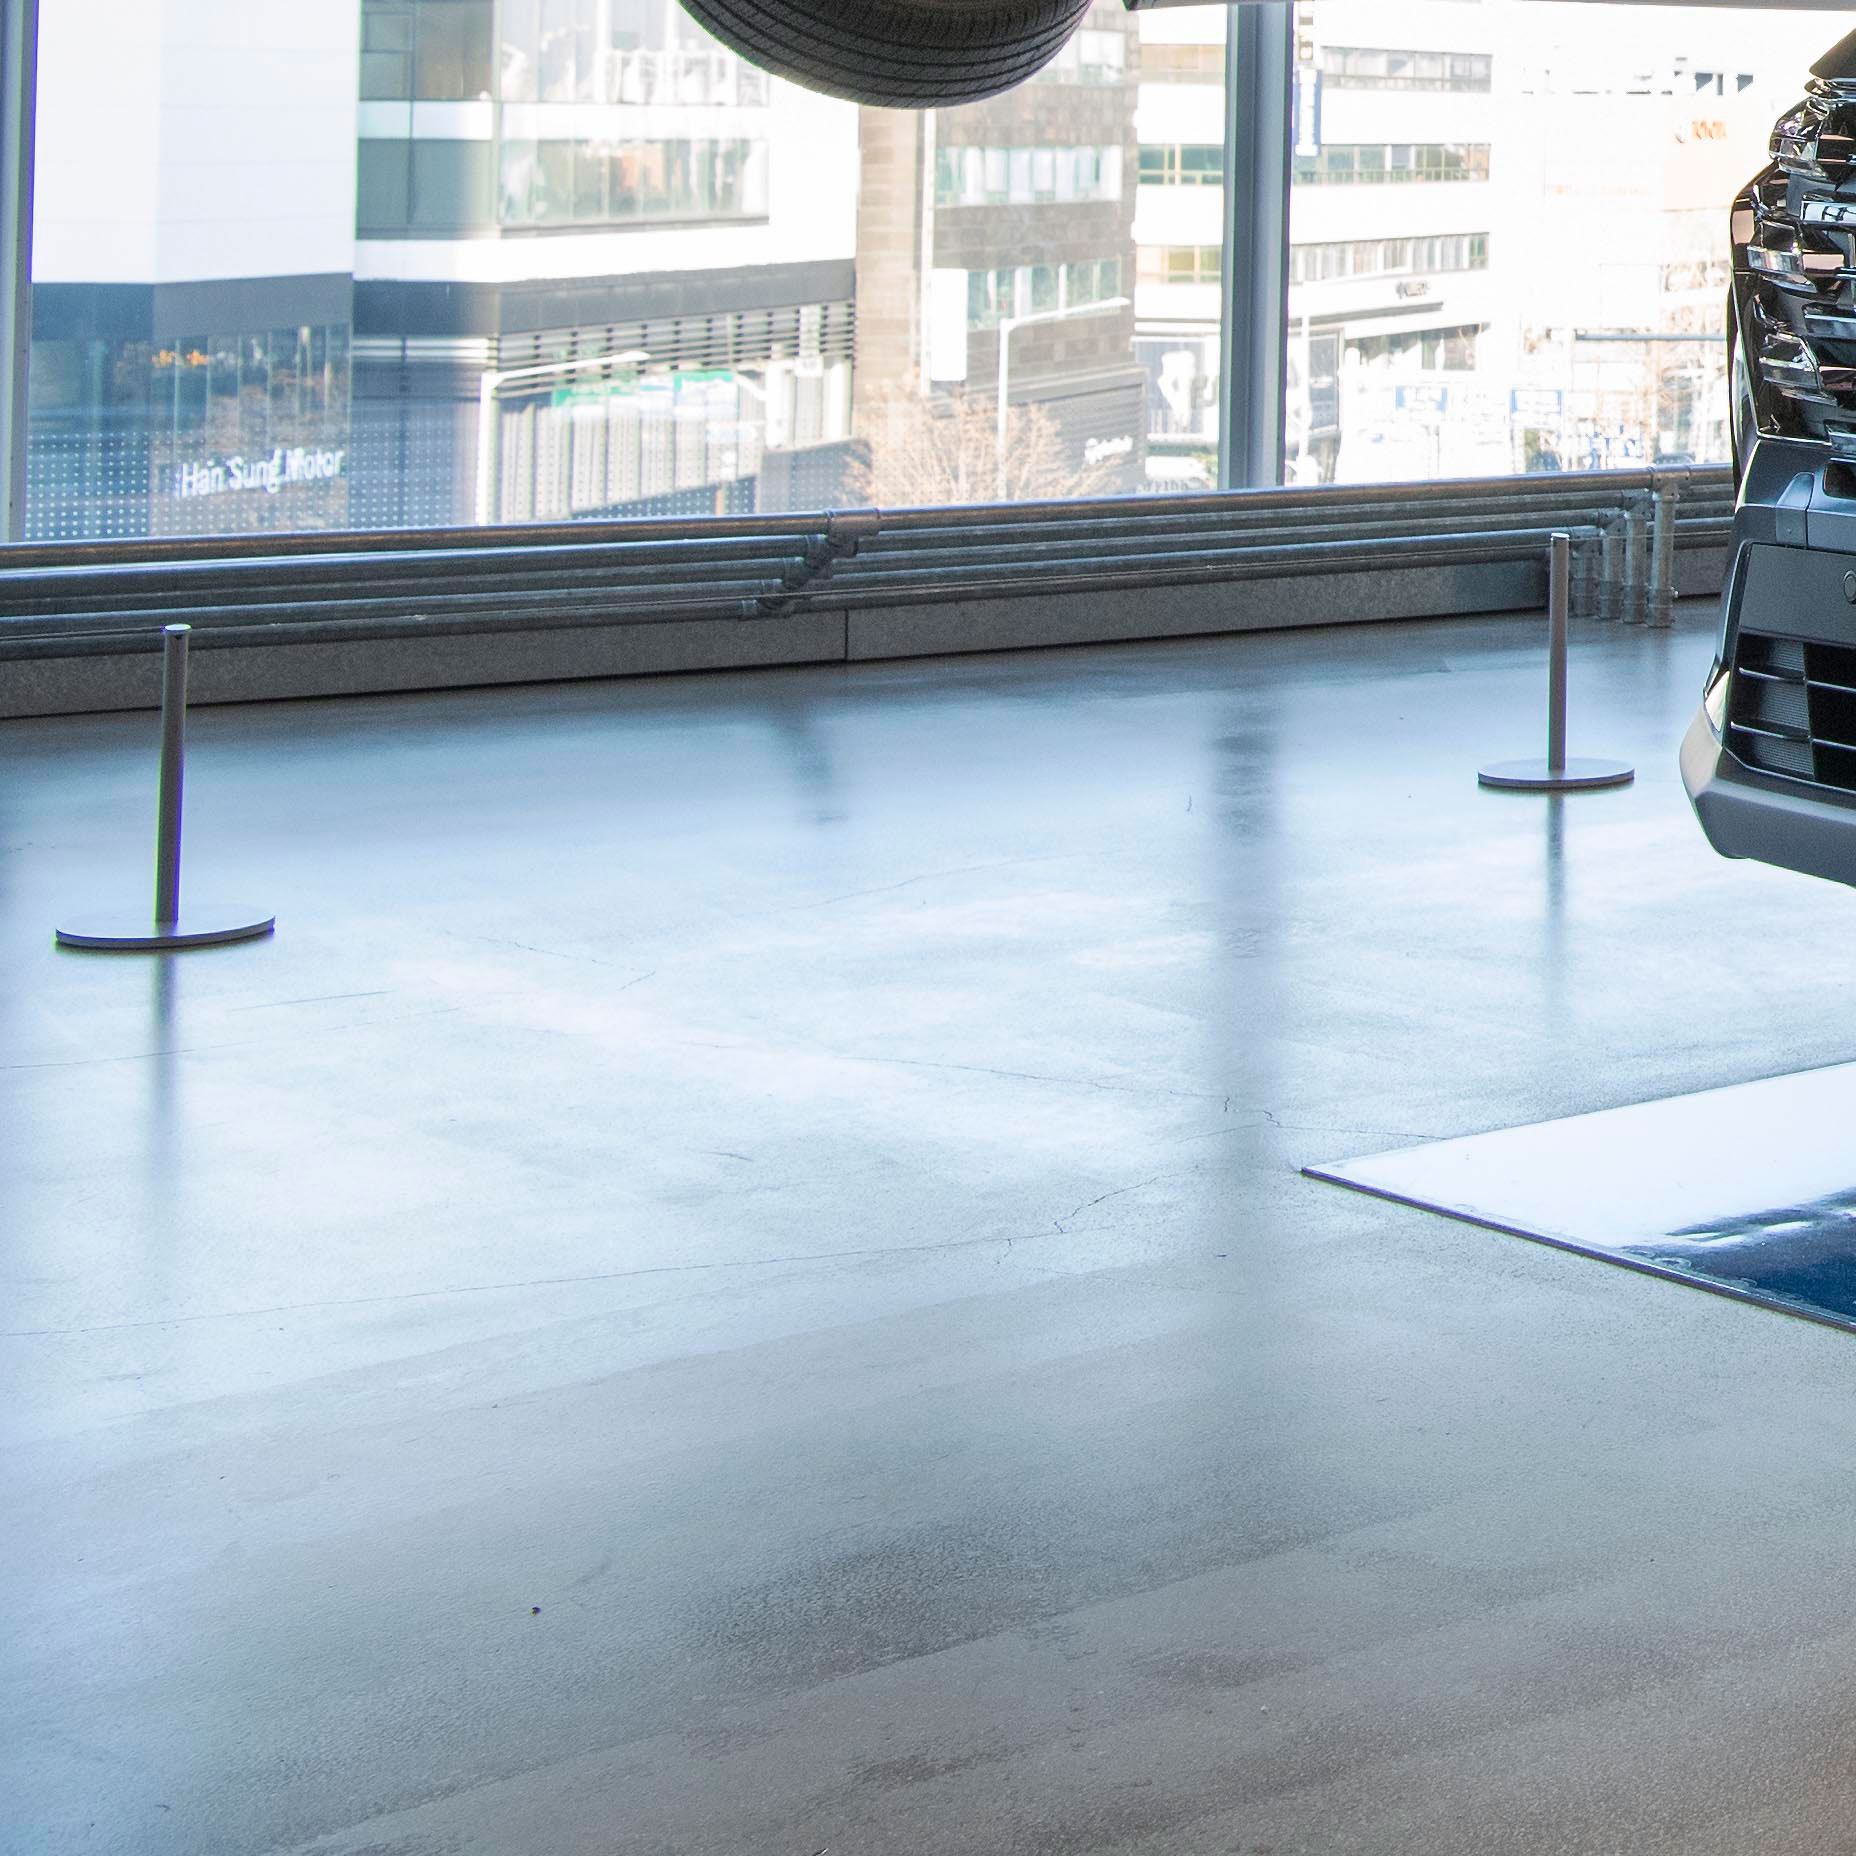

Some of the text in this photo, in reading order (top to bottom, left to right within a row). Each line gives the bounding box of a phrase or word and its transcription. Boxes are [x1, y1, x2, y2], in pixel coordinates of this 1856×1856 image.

[181, 447, 345, 498] Han Sung Motor
